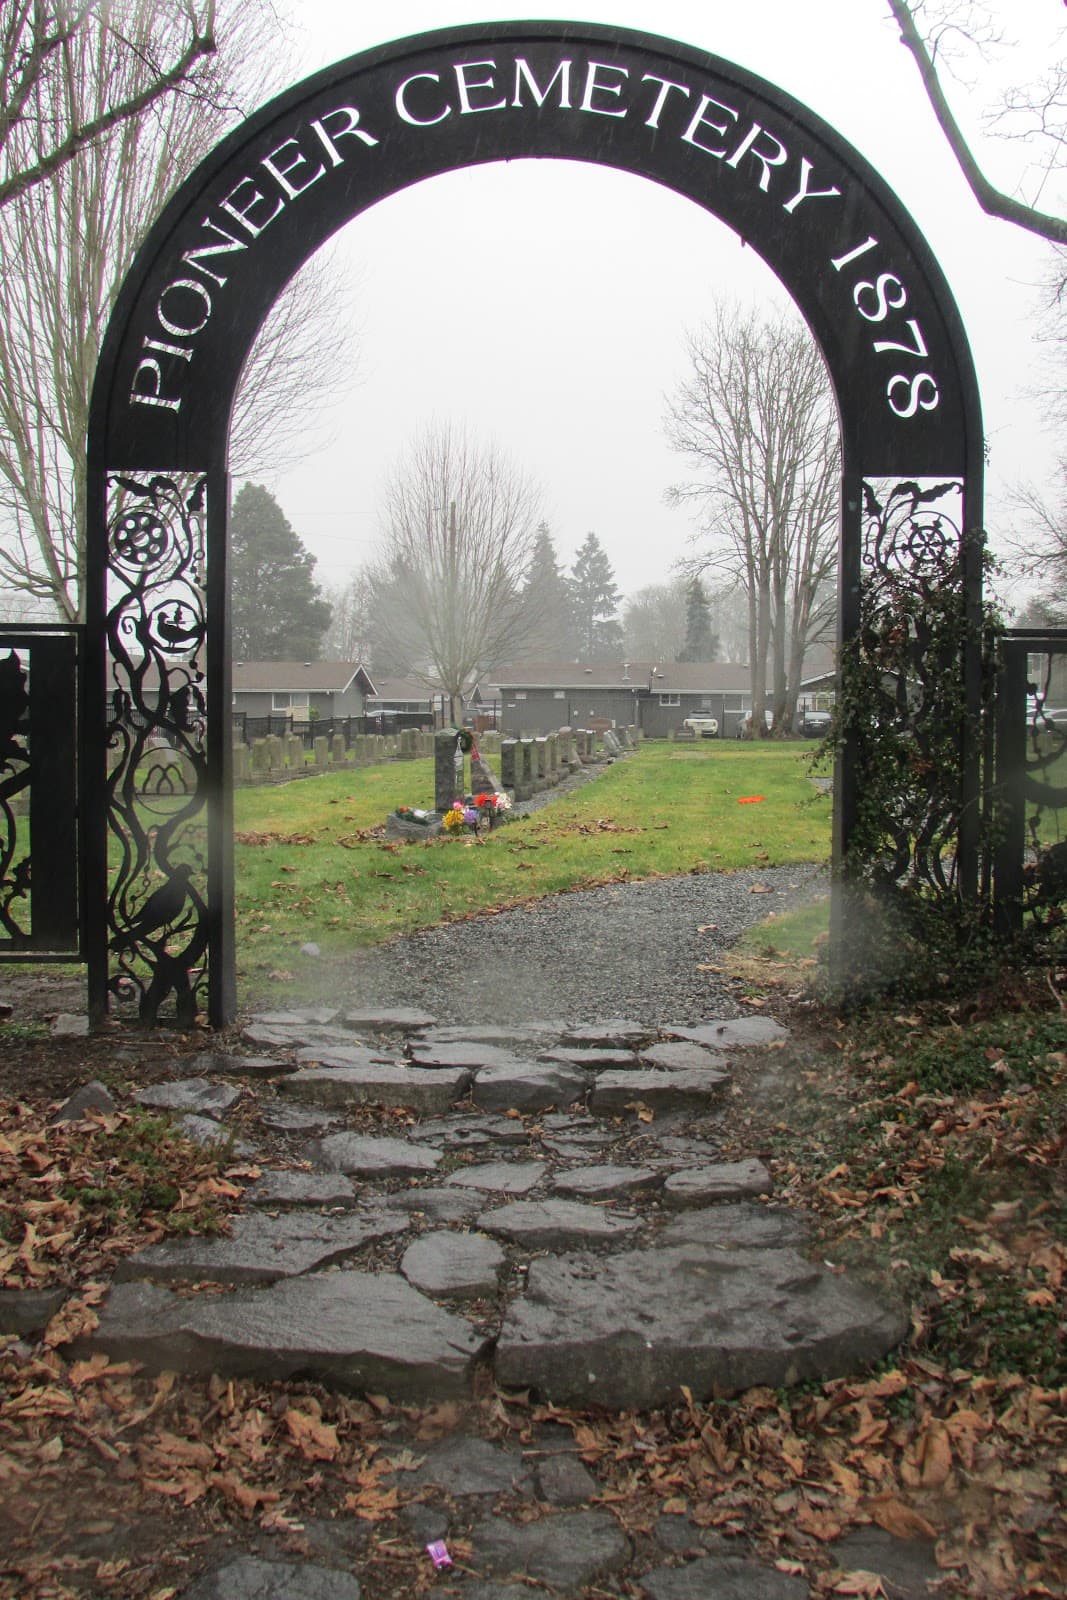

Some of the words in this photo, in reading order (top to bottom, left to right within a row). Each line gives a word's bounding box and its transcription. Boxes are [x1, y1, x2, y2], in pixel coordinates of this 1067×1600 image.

[129, 106, 380, 414] PIONEER
[395, 58, 841, 214] CEMETERY
[830, 236, 941, 419] 1878
